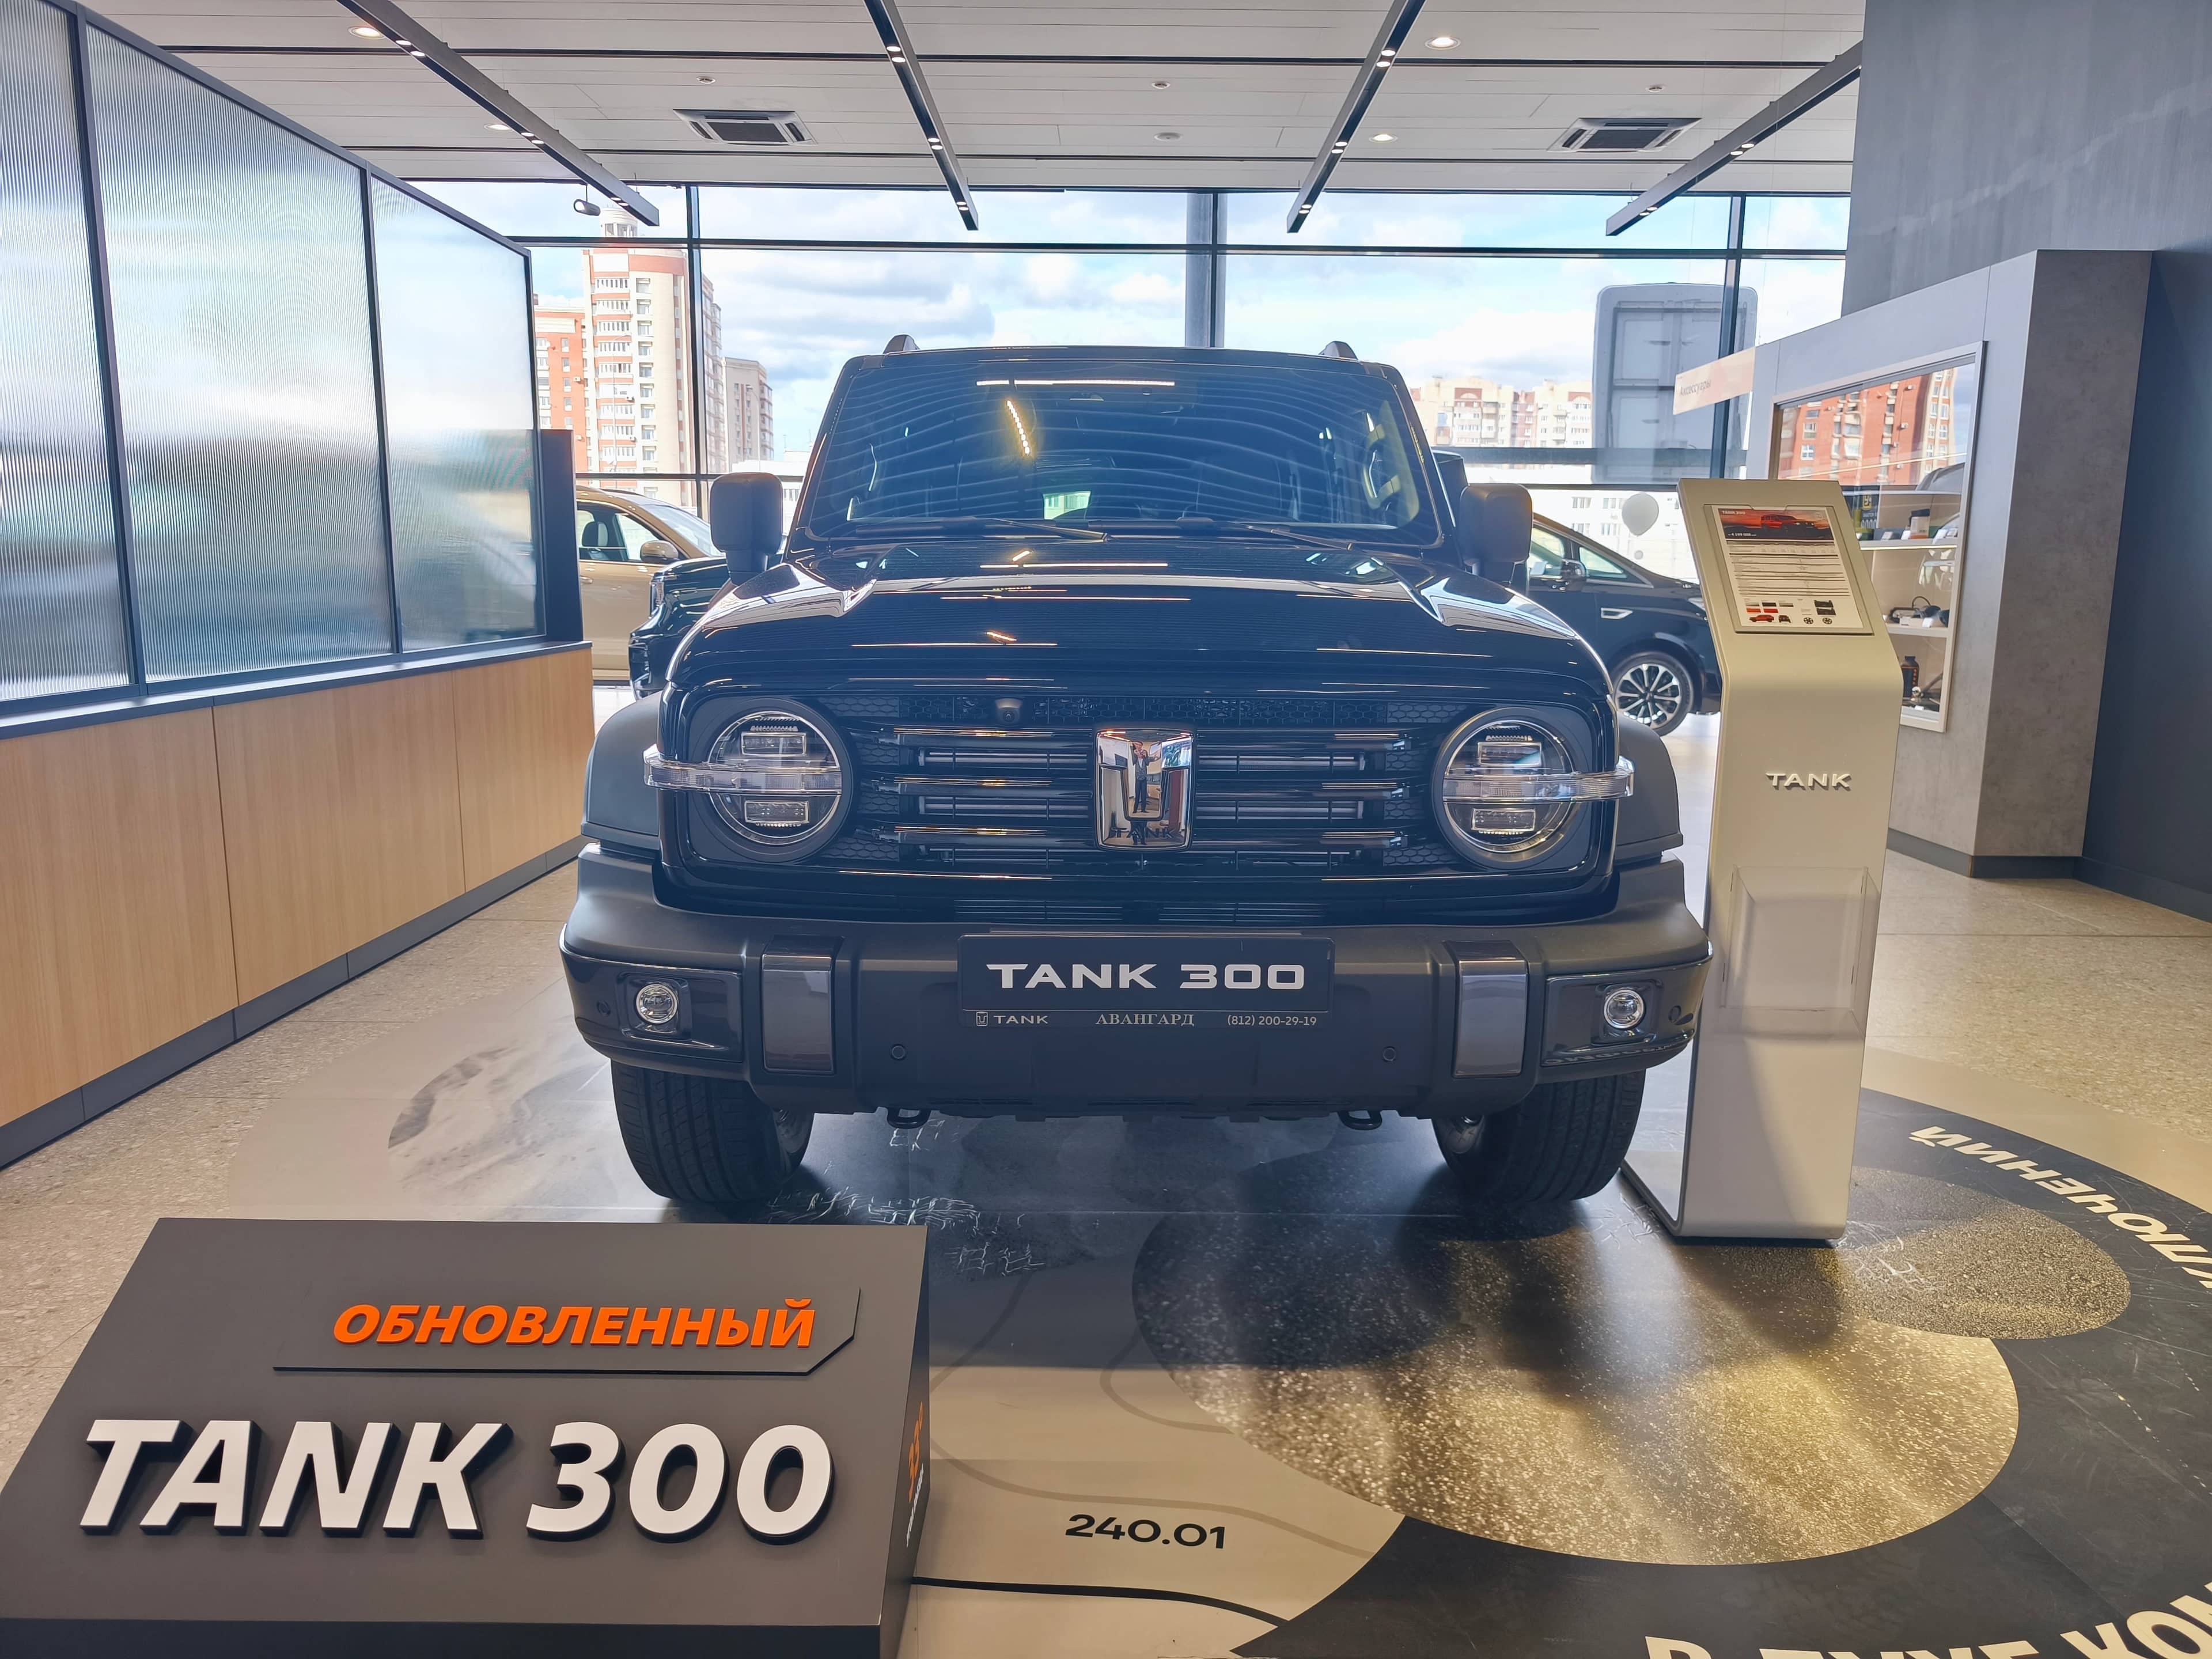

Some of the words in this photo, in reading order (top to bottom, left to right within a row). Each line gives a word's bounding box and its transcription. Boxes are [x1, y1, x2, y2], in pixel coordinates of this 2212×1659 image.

[1766, 772, 1851, 790] TANK
[986, 964, 1157, 989] TANK
[1179, 964, 1305, 990] 300
[993, 1015, 1048, 1024] TANK
[1095, 1013, 1195, 1027] АВАНГАРД
[1227, 1014, 1256, 1027] (812)
[1258, 1015, 1317, 1027] 200-29-19
[1908, 1126, 2212, 1289] ЛЮЧЕНИЙ
[332, 1298, 816, 1349] ОБНОВЛЕННЫЙ
[79, 1419, 510, 1537] TANK
[525, 1421, 835, 1544] 300
[1065, 1514, 1226, 1550] 240.01
